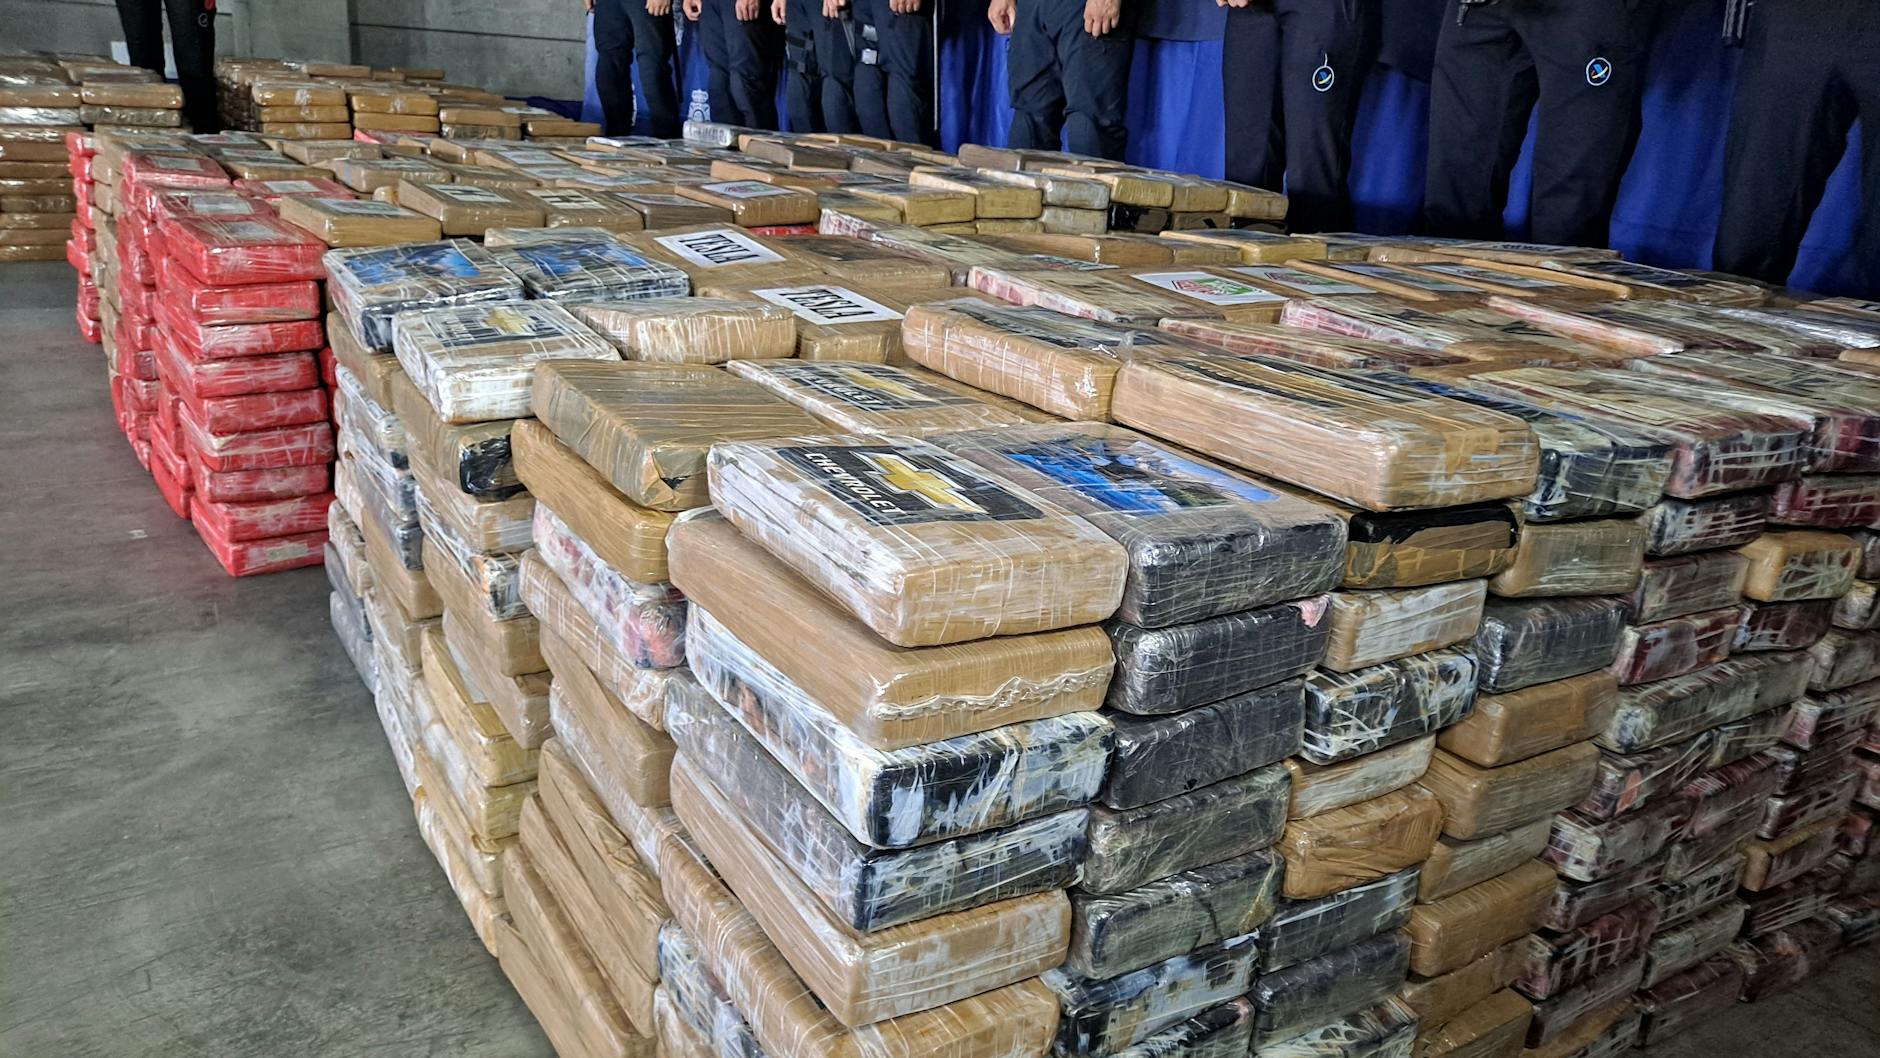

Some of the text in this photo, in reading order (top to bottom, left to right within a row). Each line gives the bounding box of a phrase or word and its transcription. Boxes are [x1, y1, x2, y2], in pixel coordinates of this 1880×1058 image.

[679, 233, 760, 264] TESLA
[779, 288, 876, 320] TESLA
[804, 451, 907, 516] CHEVROLET
